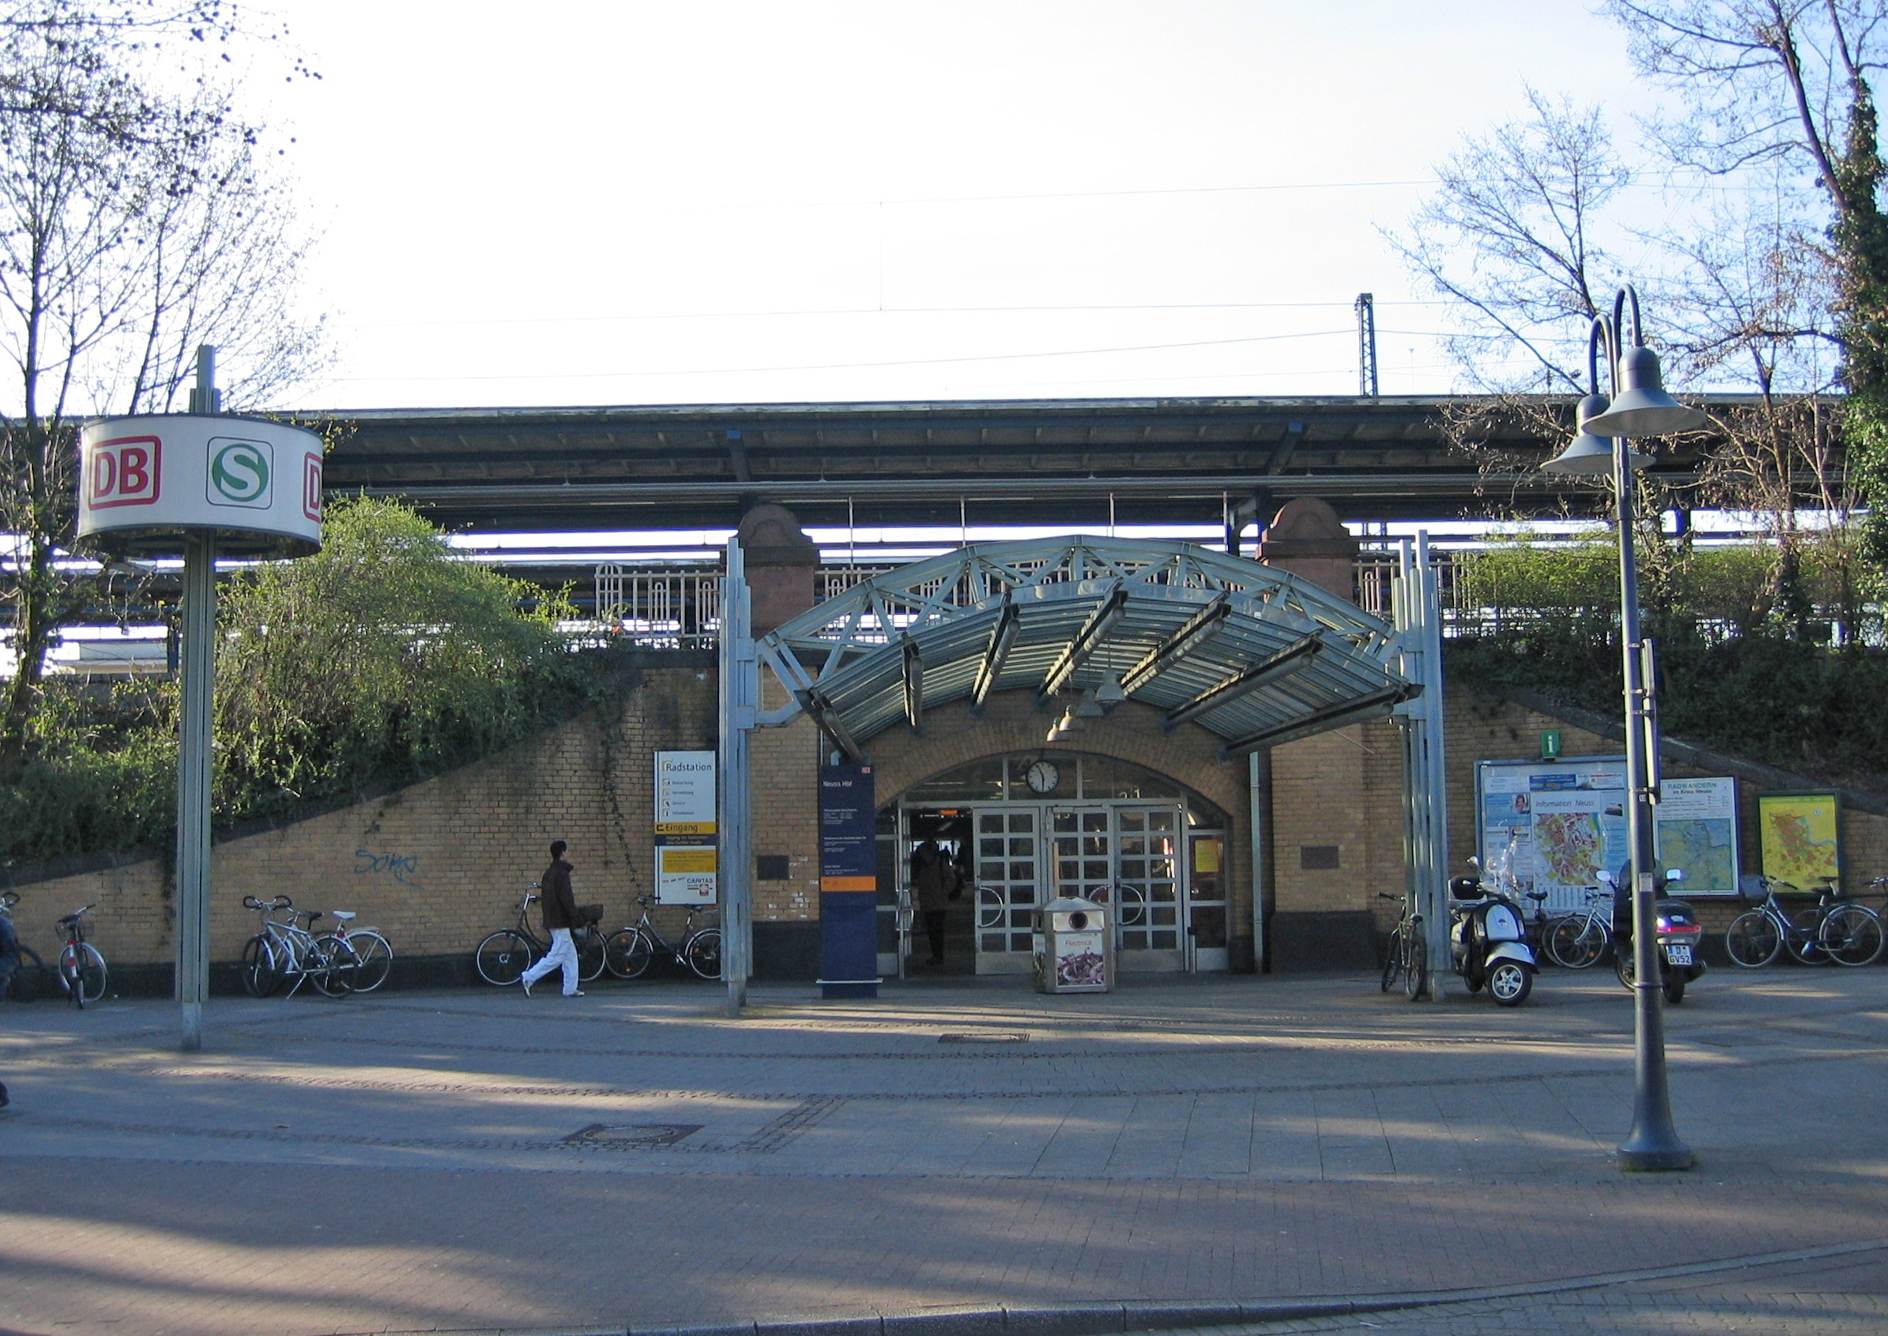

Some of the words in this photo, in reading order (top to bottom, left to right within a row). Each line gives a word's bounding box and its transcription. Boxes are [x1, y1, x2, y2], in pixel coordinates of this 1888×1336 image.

[94, 447, 149, 498] DB
[666, 762, 712, 772] Radstation
[1667, 782, 1717, 790] RADWANDERN
[1535, 799, 1572, 807] Information
[1575, 798, 1595, 807] Neuss
[666, 824, 698, 834] Eingang
[1675, 946, 1682, 954] D
